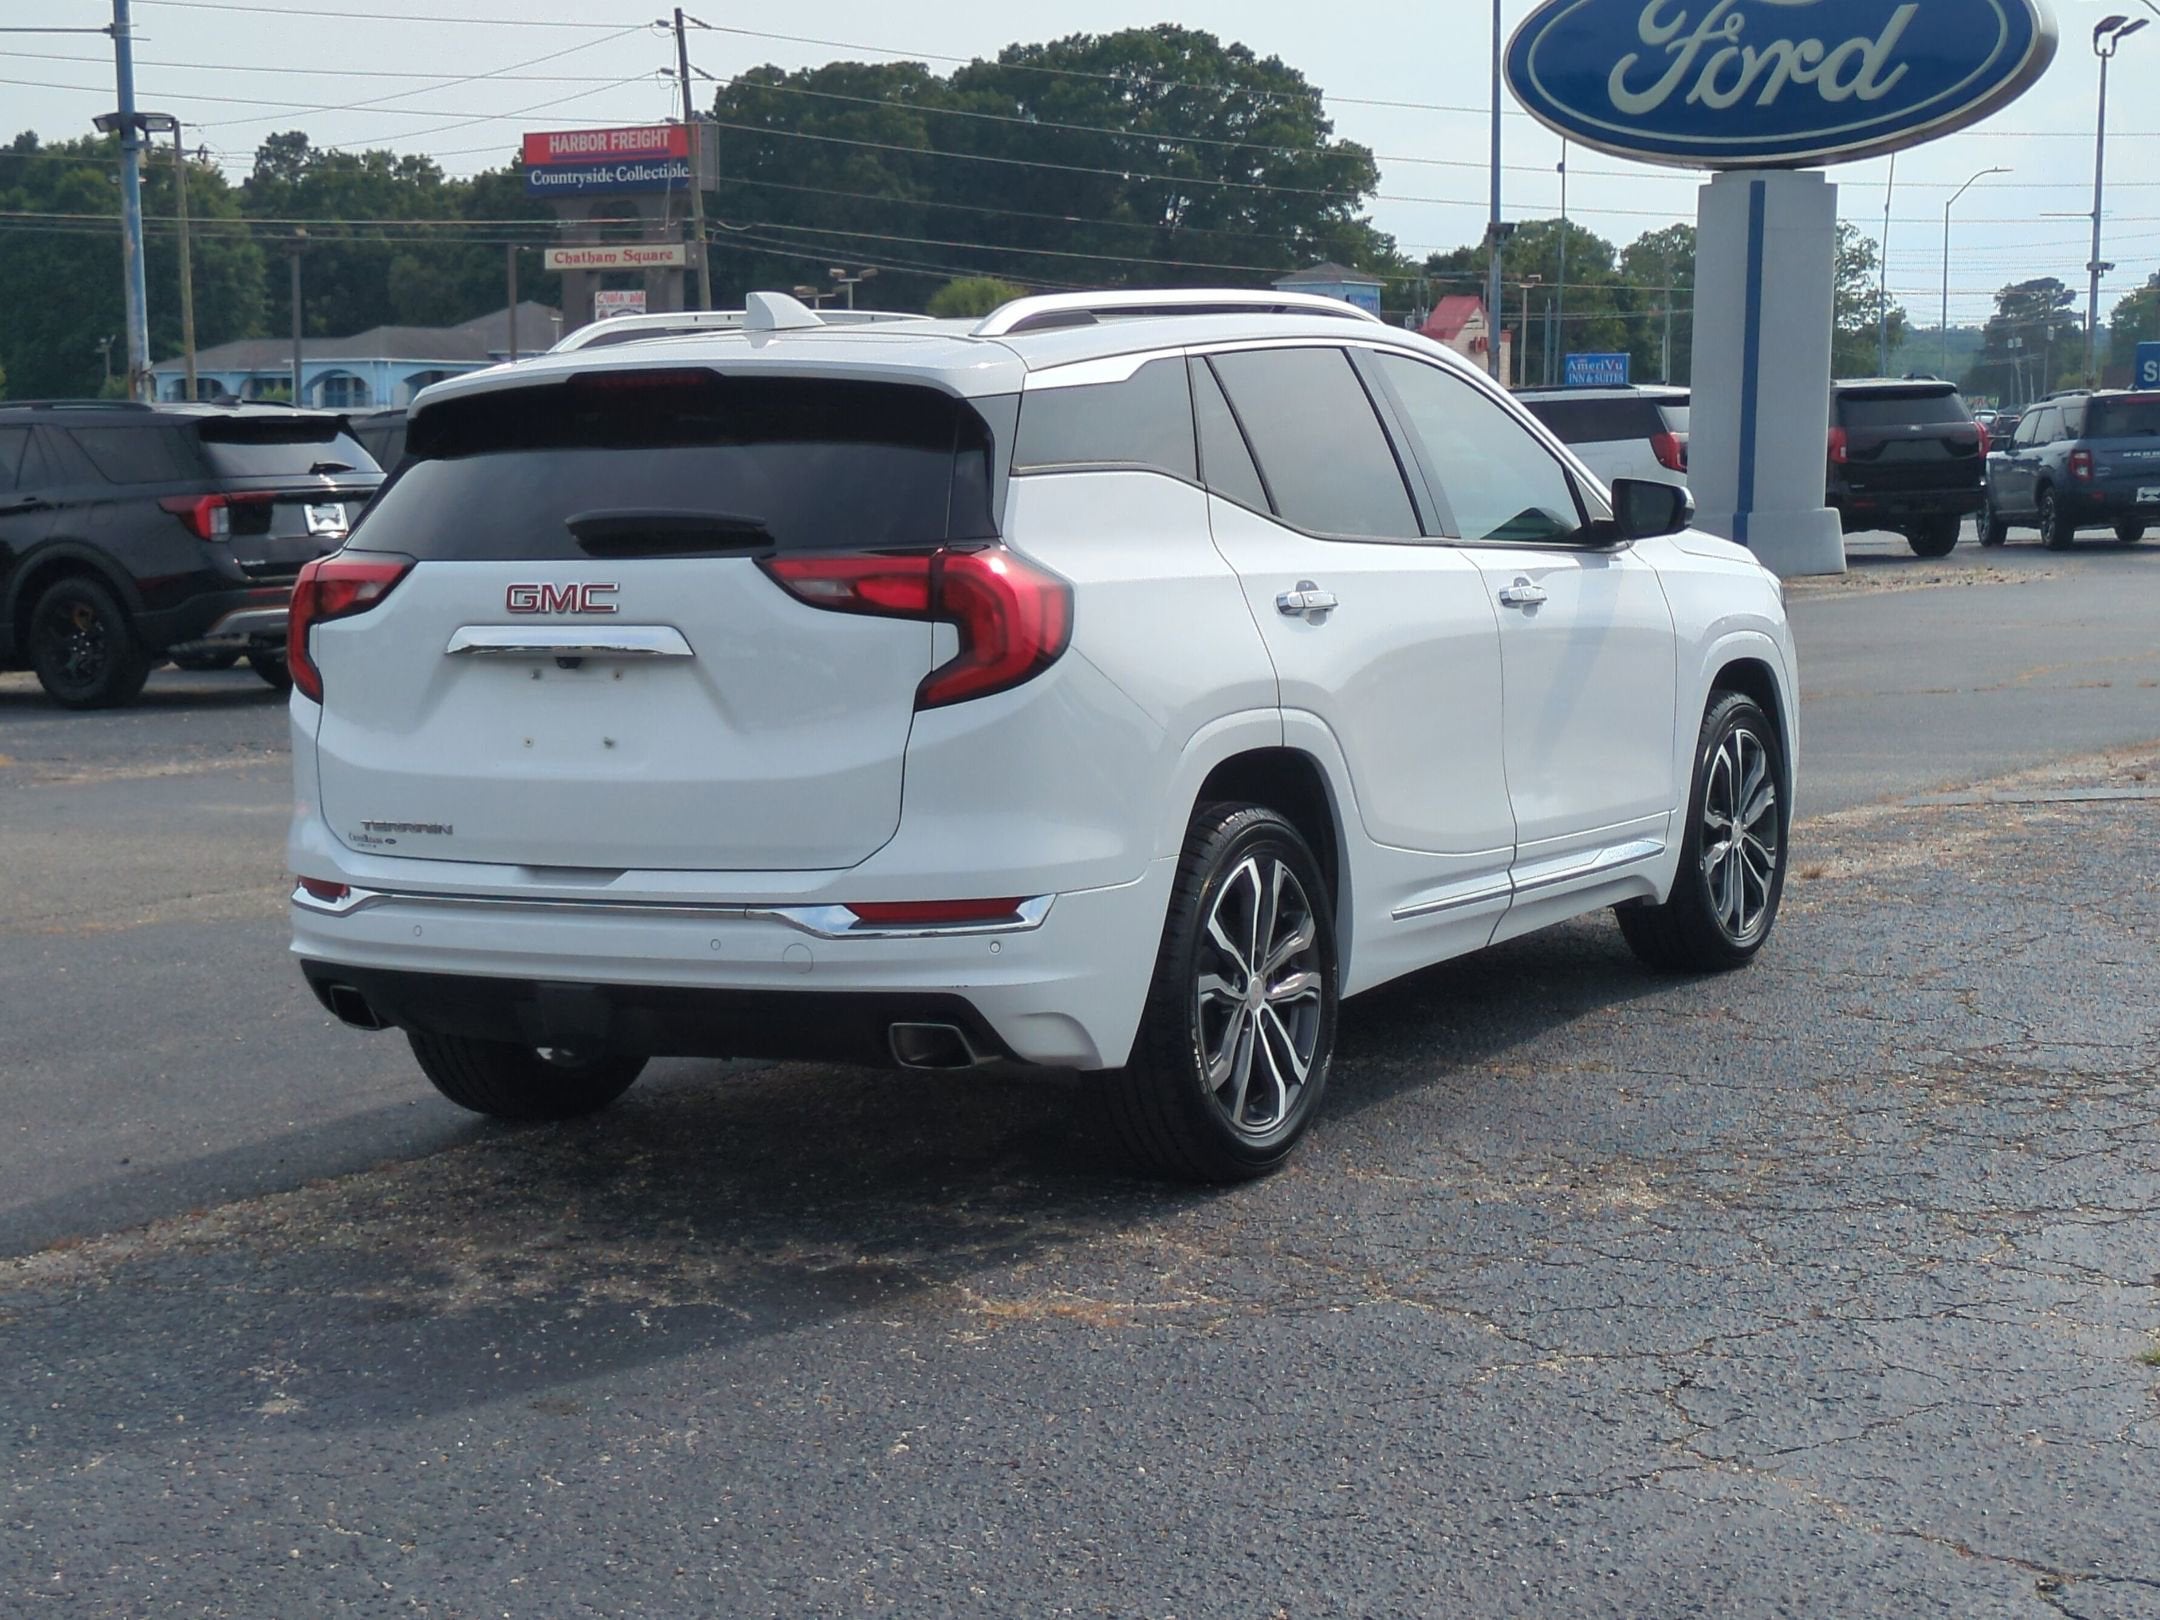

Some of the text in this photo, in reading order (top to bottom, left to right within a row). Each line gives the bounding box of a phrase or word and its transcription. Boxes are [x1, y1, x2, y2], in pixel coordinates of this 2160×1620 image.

[1608, 0, 1911, 114] Ford
[550, 129, 671, 152] HARBOR FREIGHT
[531, 167, 614, 188] Countryside
[554, 249, 673, 264] Chatham Square
[1568, 359, 1624, 371] AmeriVu
[2143, 360, 2160, 382] S
[506, 582, 619, 614] GMC
[361, 819, 453, 835] TERRAIN
